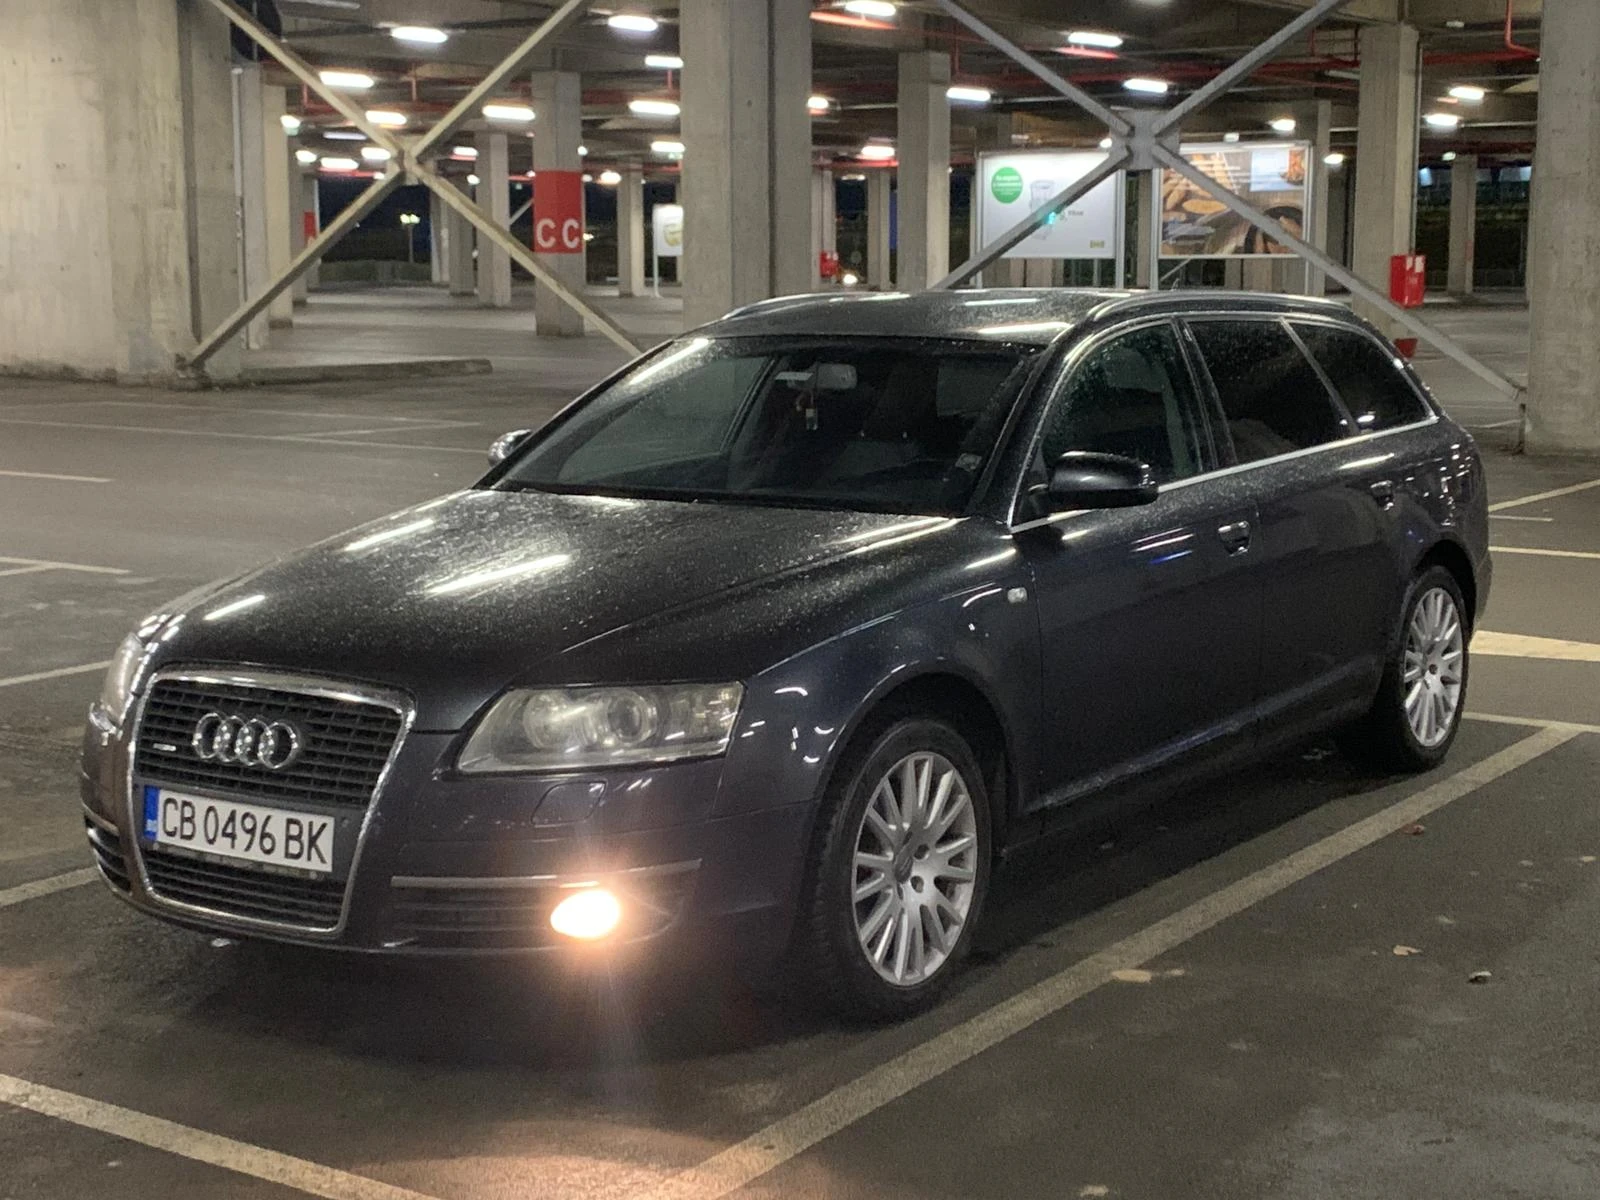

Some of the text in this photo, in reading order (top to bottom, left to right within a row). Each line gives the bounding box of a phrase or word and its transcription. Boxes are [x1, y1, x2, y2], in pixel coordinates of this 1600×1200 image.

[163, 797, 328, 865] CB 0496 BK
